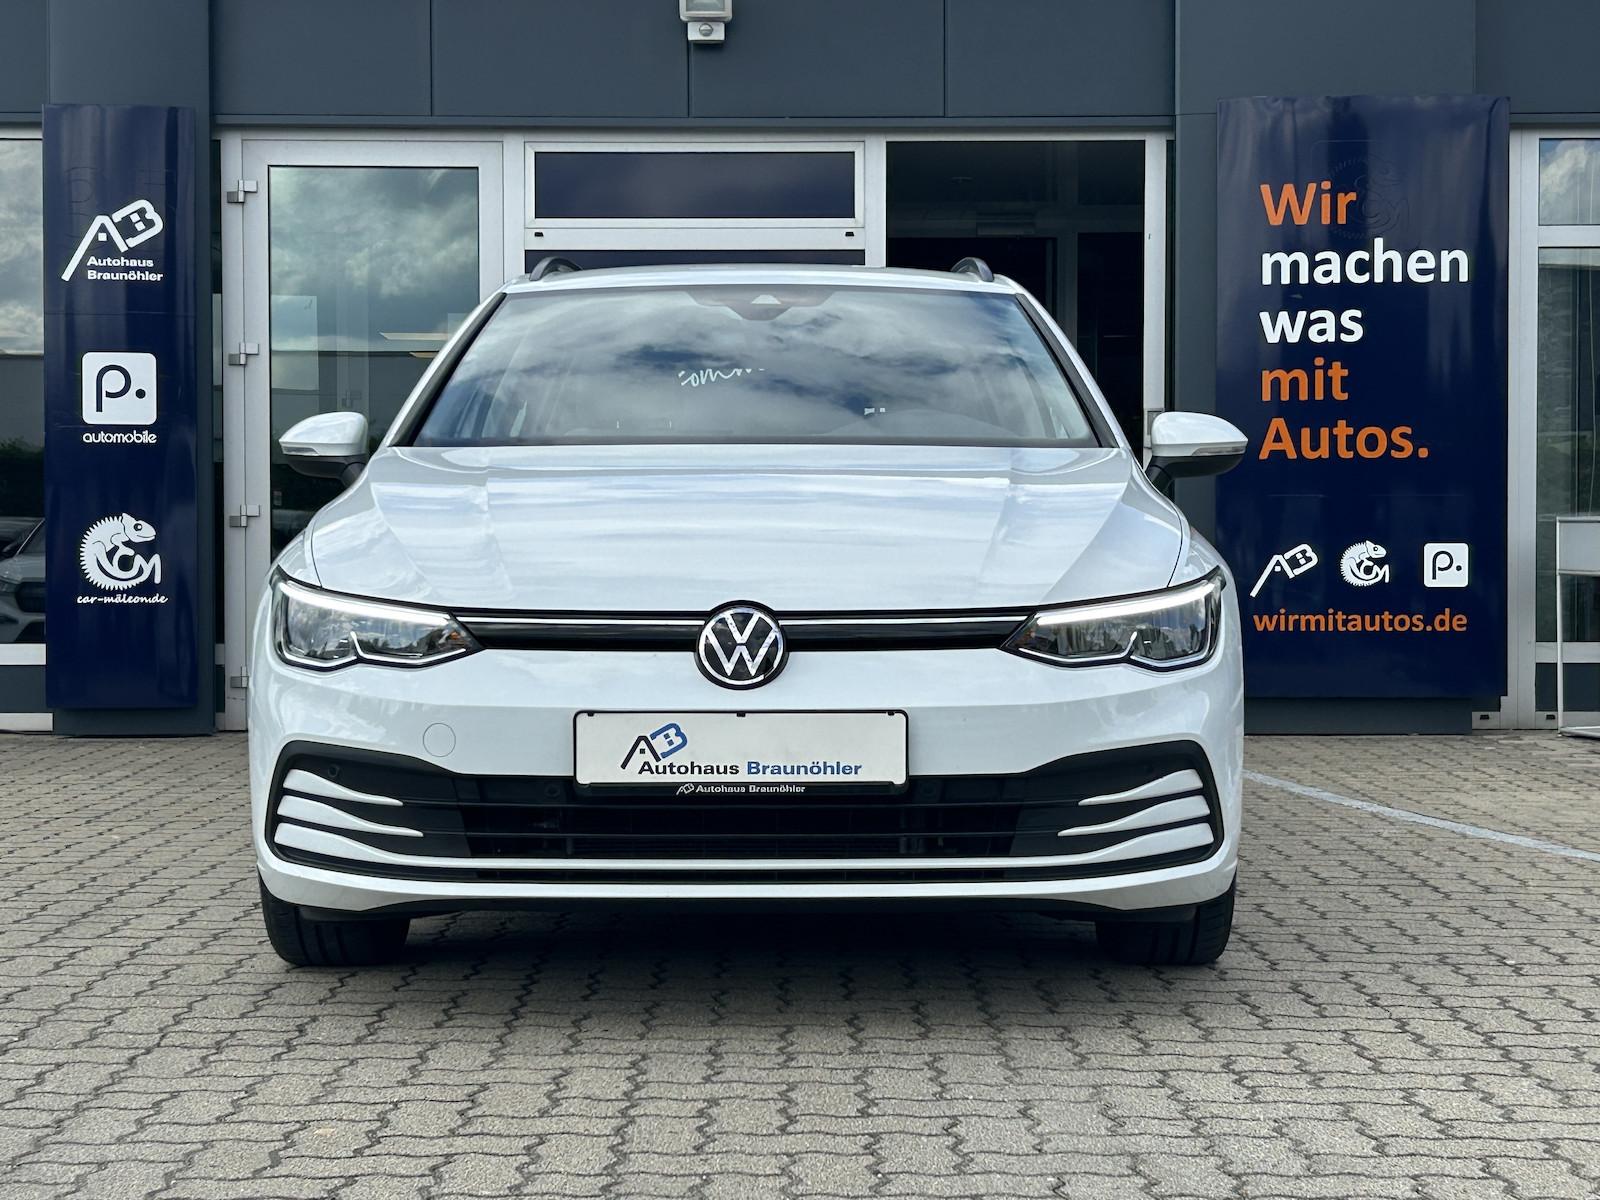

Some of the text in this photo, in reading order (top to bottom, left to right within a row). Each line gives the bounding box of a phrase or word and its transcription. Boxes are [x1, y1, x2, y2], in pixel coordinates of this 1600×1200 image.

[1260, 181, 1357, 226] Wir
[87, 256, 154, 267] Autohaus
[1261, 237, 1469, 286] machen
[87, 269, 163, 281] Braunöhler
[1259, 307, 1364, 343] was
[1261, 357, 1349, 402] mit
[82, 430, 157, 443] automobile
[1258, 417, 1429, 460] Autos.
[1252, 608, 1468, 632] wirmitautos.de
[637, 761, 862, 775] Autohaus Braunöhler
[695, 784, 746, 793] Autohaus
[748, 784, 806, 793] Braunöhler
